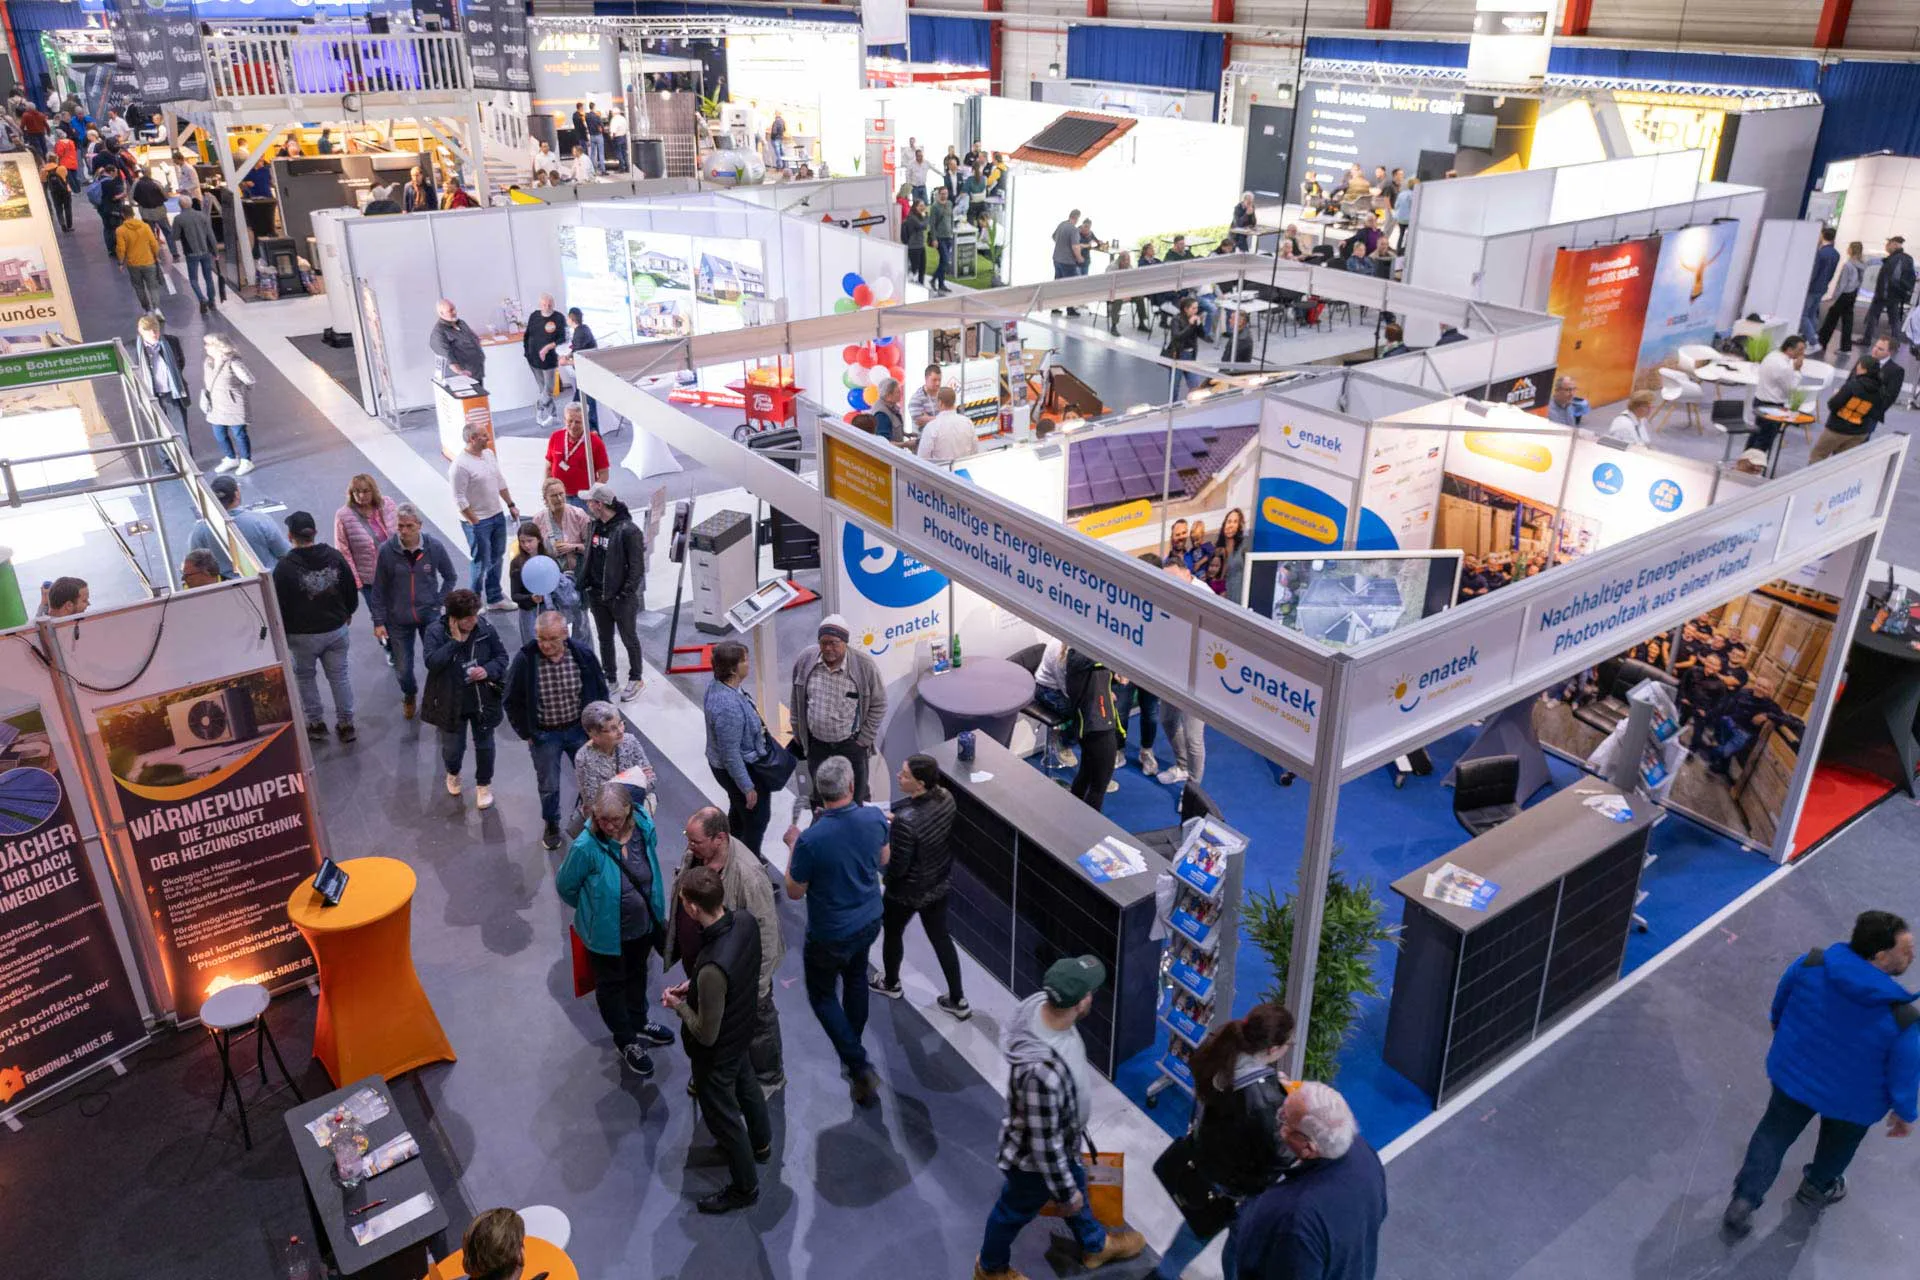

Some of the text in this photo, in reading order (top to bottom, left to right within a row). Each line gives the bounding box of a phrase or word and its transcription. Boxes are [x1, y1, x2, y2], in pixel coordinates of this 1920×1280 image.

[1315, 89, 1465, 115] WIR MACHEN WATT GEHT
[0, 305, 57, 322] undes
[26, 352, 111, 372] Bohrtechnik
[1299, 429, 1342, 453] enatek
[1828, 479, 1863, 509] enatek
[1086, 511, 1144, 532] www.enatek.de
[1271, 506, 1329, 535] www.enatek.de
[907, 481, 989, 537] Nachhaltige
[994, 526, 1154, 623] Energieversorgung
[923, 516, 1143, 647] Photovoltaik aus einer Hand
[1540, 578, 1633, 632] Nachhaltige
[1636, 523, 1762, 590] Energieversorgung
[1553, 548, 1753, 655] Photovoltaik aus einer Hand
[885, 609, 940, 640] enatek
[1418, 646, 1479, 690] enatek
[1239, 664, 1317, 718] enatek
[1427, 674, 1474, 700] immer sonnig
[1251, 695, 1311, 734] immer sonnig
[129, 772, 305, 842] WÄRMEPUMPEN
[150, 813, 304, 872] DER HEIZUNGSTECHNIK
[178, 808, 265, 846] DIE ZUKUNFT
[2, 850, 72, 891] IHR DACH
[161, 858, 241, 888] Ökologisch Heizen
[168, 878, 256, 911] Individuelle Auswahl
[0, 902, 102, 952] angfristigen Pachteinnahmen
[171, 912, 198, 924] Marken
[173, 902, 261, 936] Fördermöglichkeiten
[55, 936, 90, 956] komplette
[188, 922, 290, 964] Ideal komobinierbar
[7, 967, 40, 986] Wartung
[22, 973, 73, 1002] Energiewende
[20, 992, 84, 1029] Dachfläche
[85, 979, 110, 998] oder
[7, 1002, 91, 1048] 4ha Landläche
[24, 1031, 114, 1085] REGIONAL-HAUS.DE
